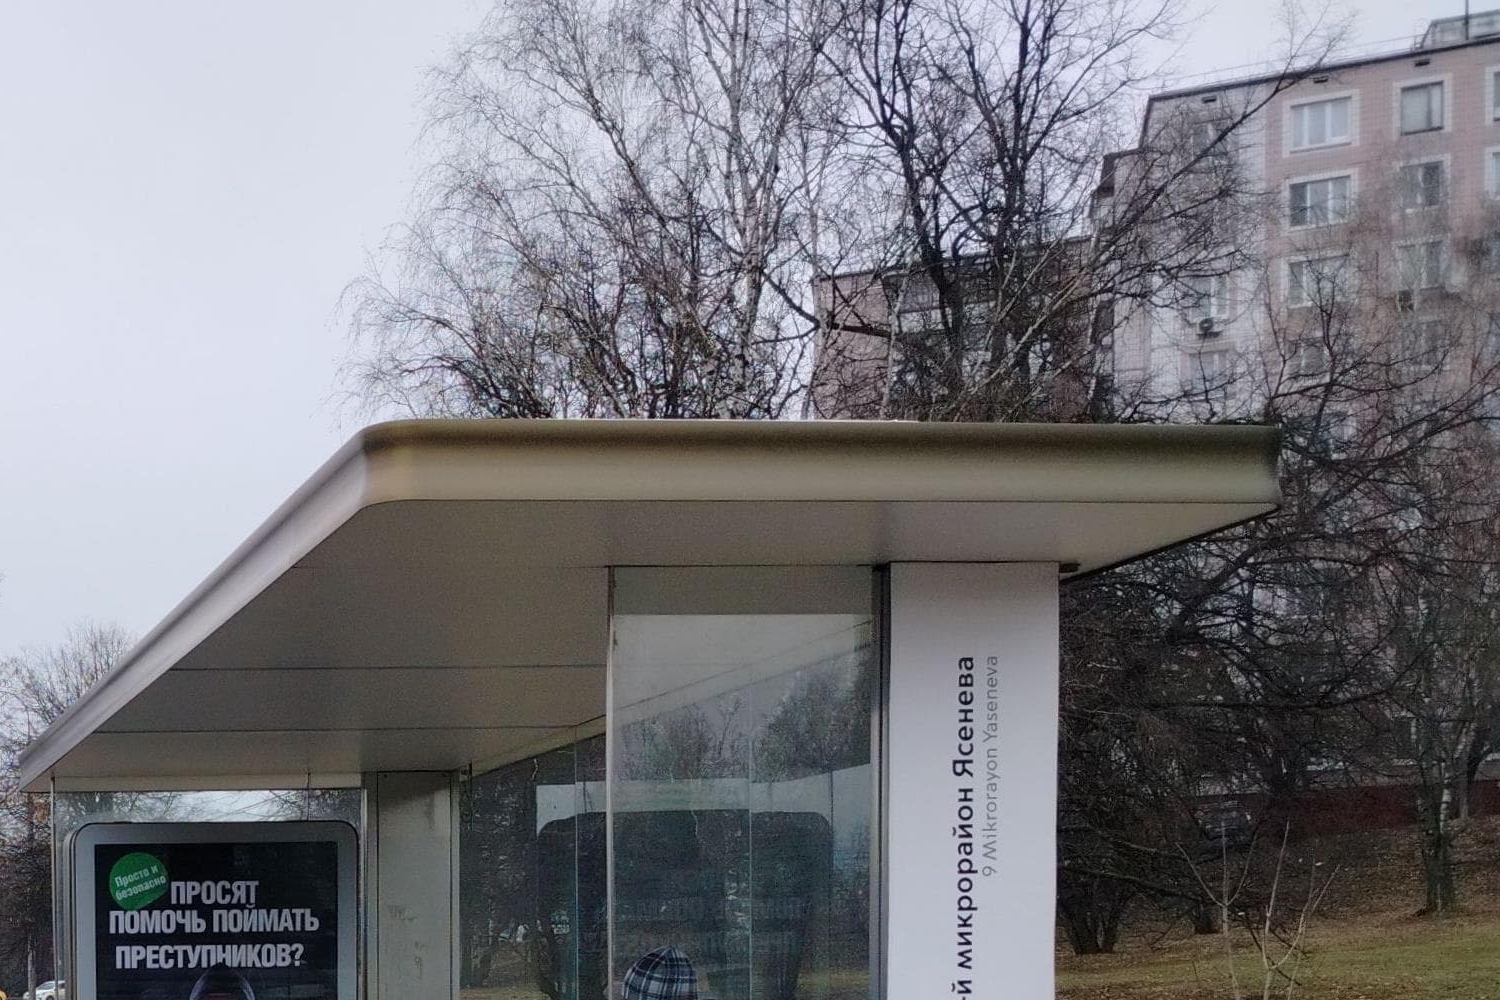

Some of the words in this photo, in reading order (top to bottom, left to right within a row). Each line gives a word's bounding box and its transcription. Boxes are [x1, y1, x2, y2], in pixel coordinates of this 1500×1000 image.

[982, 655, 998, 743] Yaseneva
[952, 656, 974, 778] Ясенева
[981, 748, 1001, 861] Mikrorayon
[114, 868, 150, 888] Просто
[150, 865, 159, 875] и
[952, 787, 978, 970] микрорайон
[982, 865, 997, 877] 9
[115, 875, 167, 901] безопасно
[170, 880, 260, 905] ПРОСЯТ
[109, 909, 207, 934] ПОМОЧЬ
[212, 904, 320, 933] ПОЙМАТЬ
[115, 943, 305, 970] ПРЕСТУПНИКОВ?
